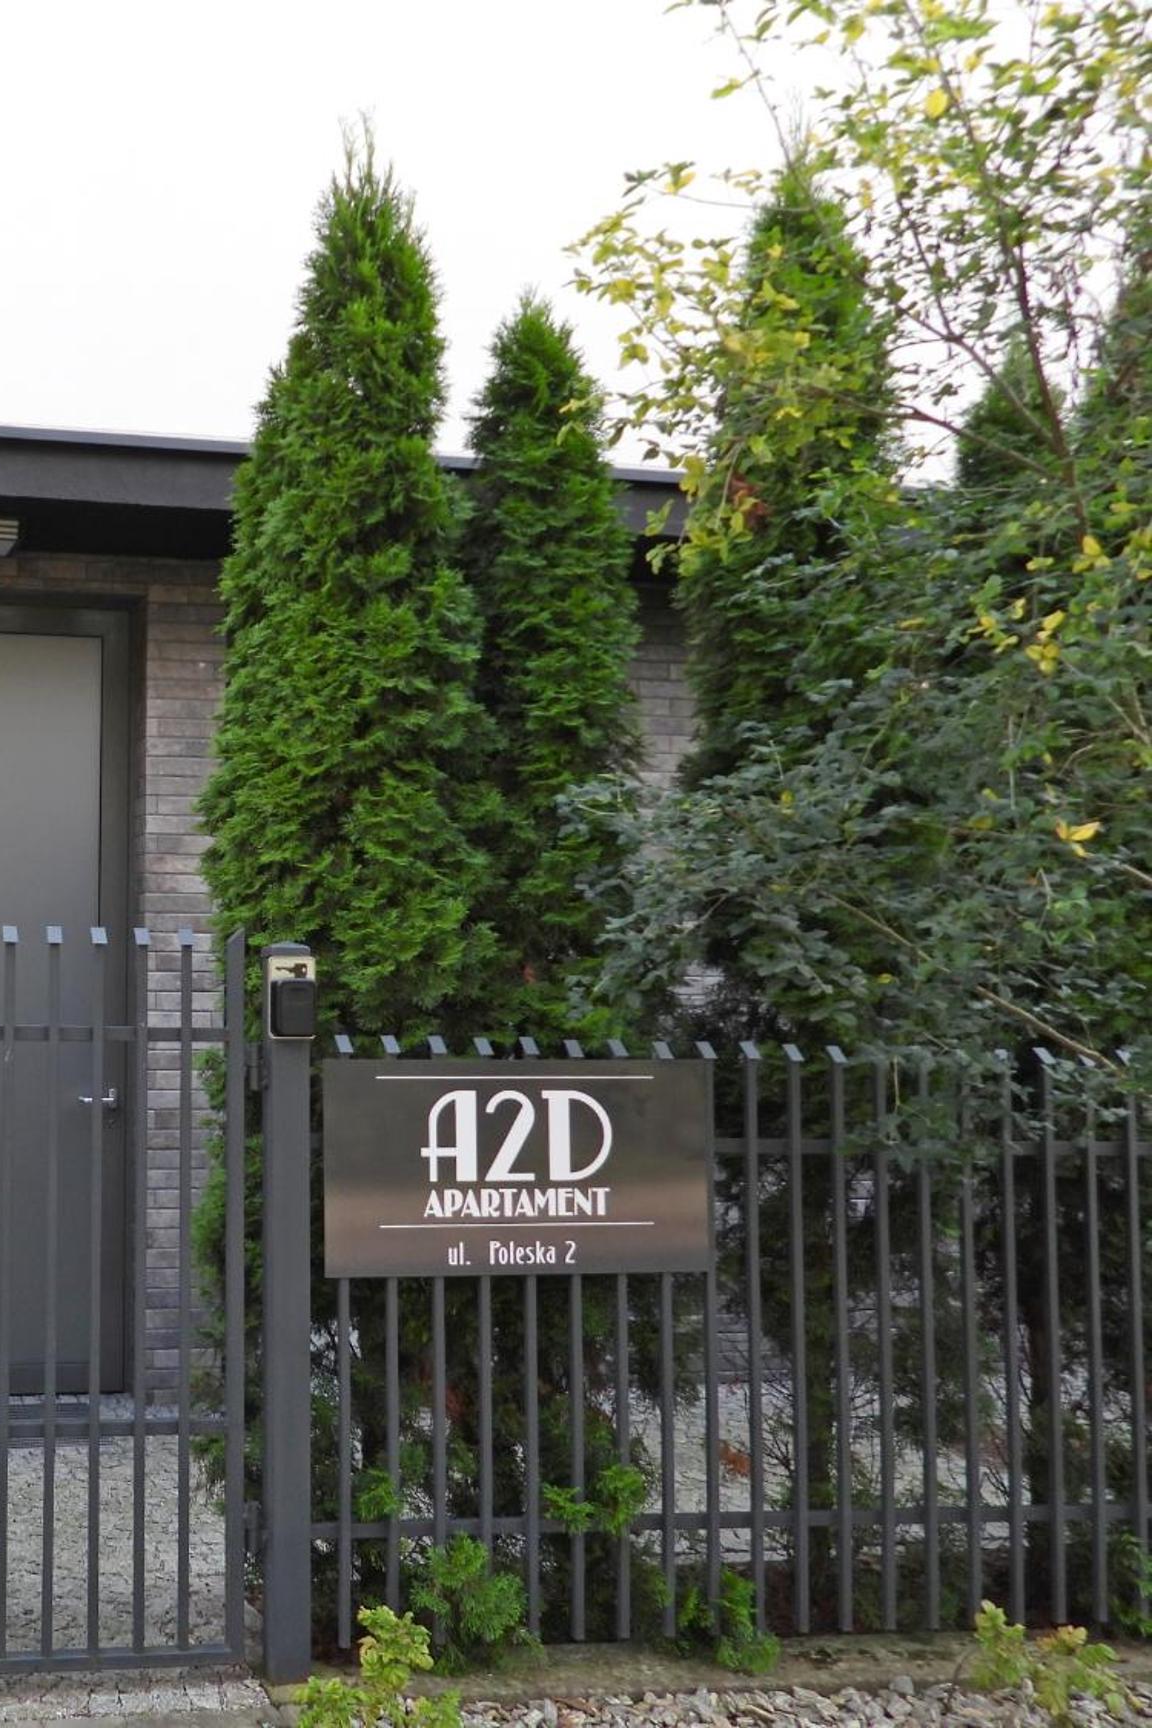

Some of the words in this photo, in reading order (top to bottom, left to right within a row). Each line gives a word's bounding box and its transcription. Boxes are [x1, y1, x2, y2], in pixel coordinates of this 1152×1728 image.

[420, 1090, 613, 1182] A2D
[423, 1187, 611, 1218] APARTAMENT
[448, 1241, 471, 1266] ul.
[489, 1240, 556, 1265] Poleska
[565, 1240, 576, 1264] 2
